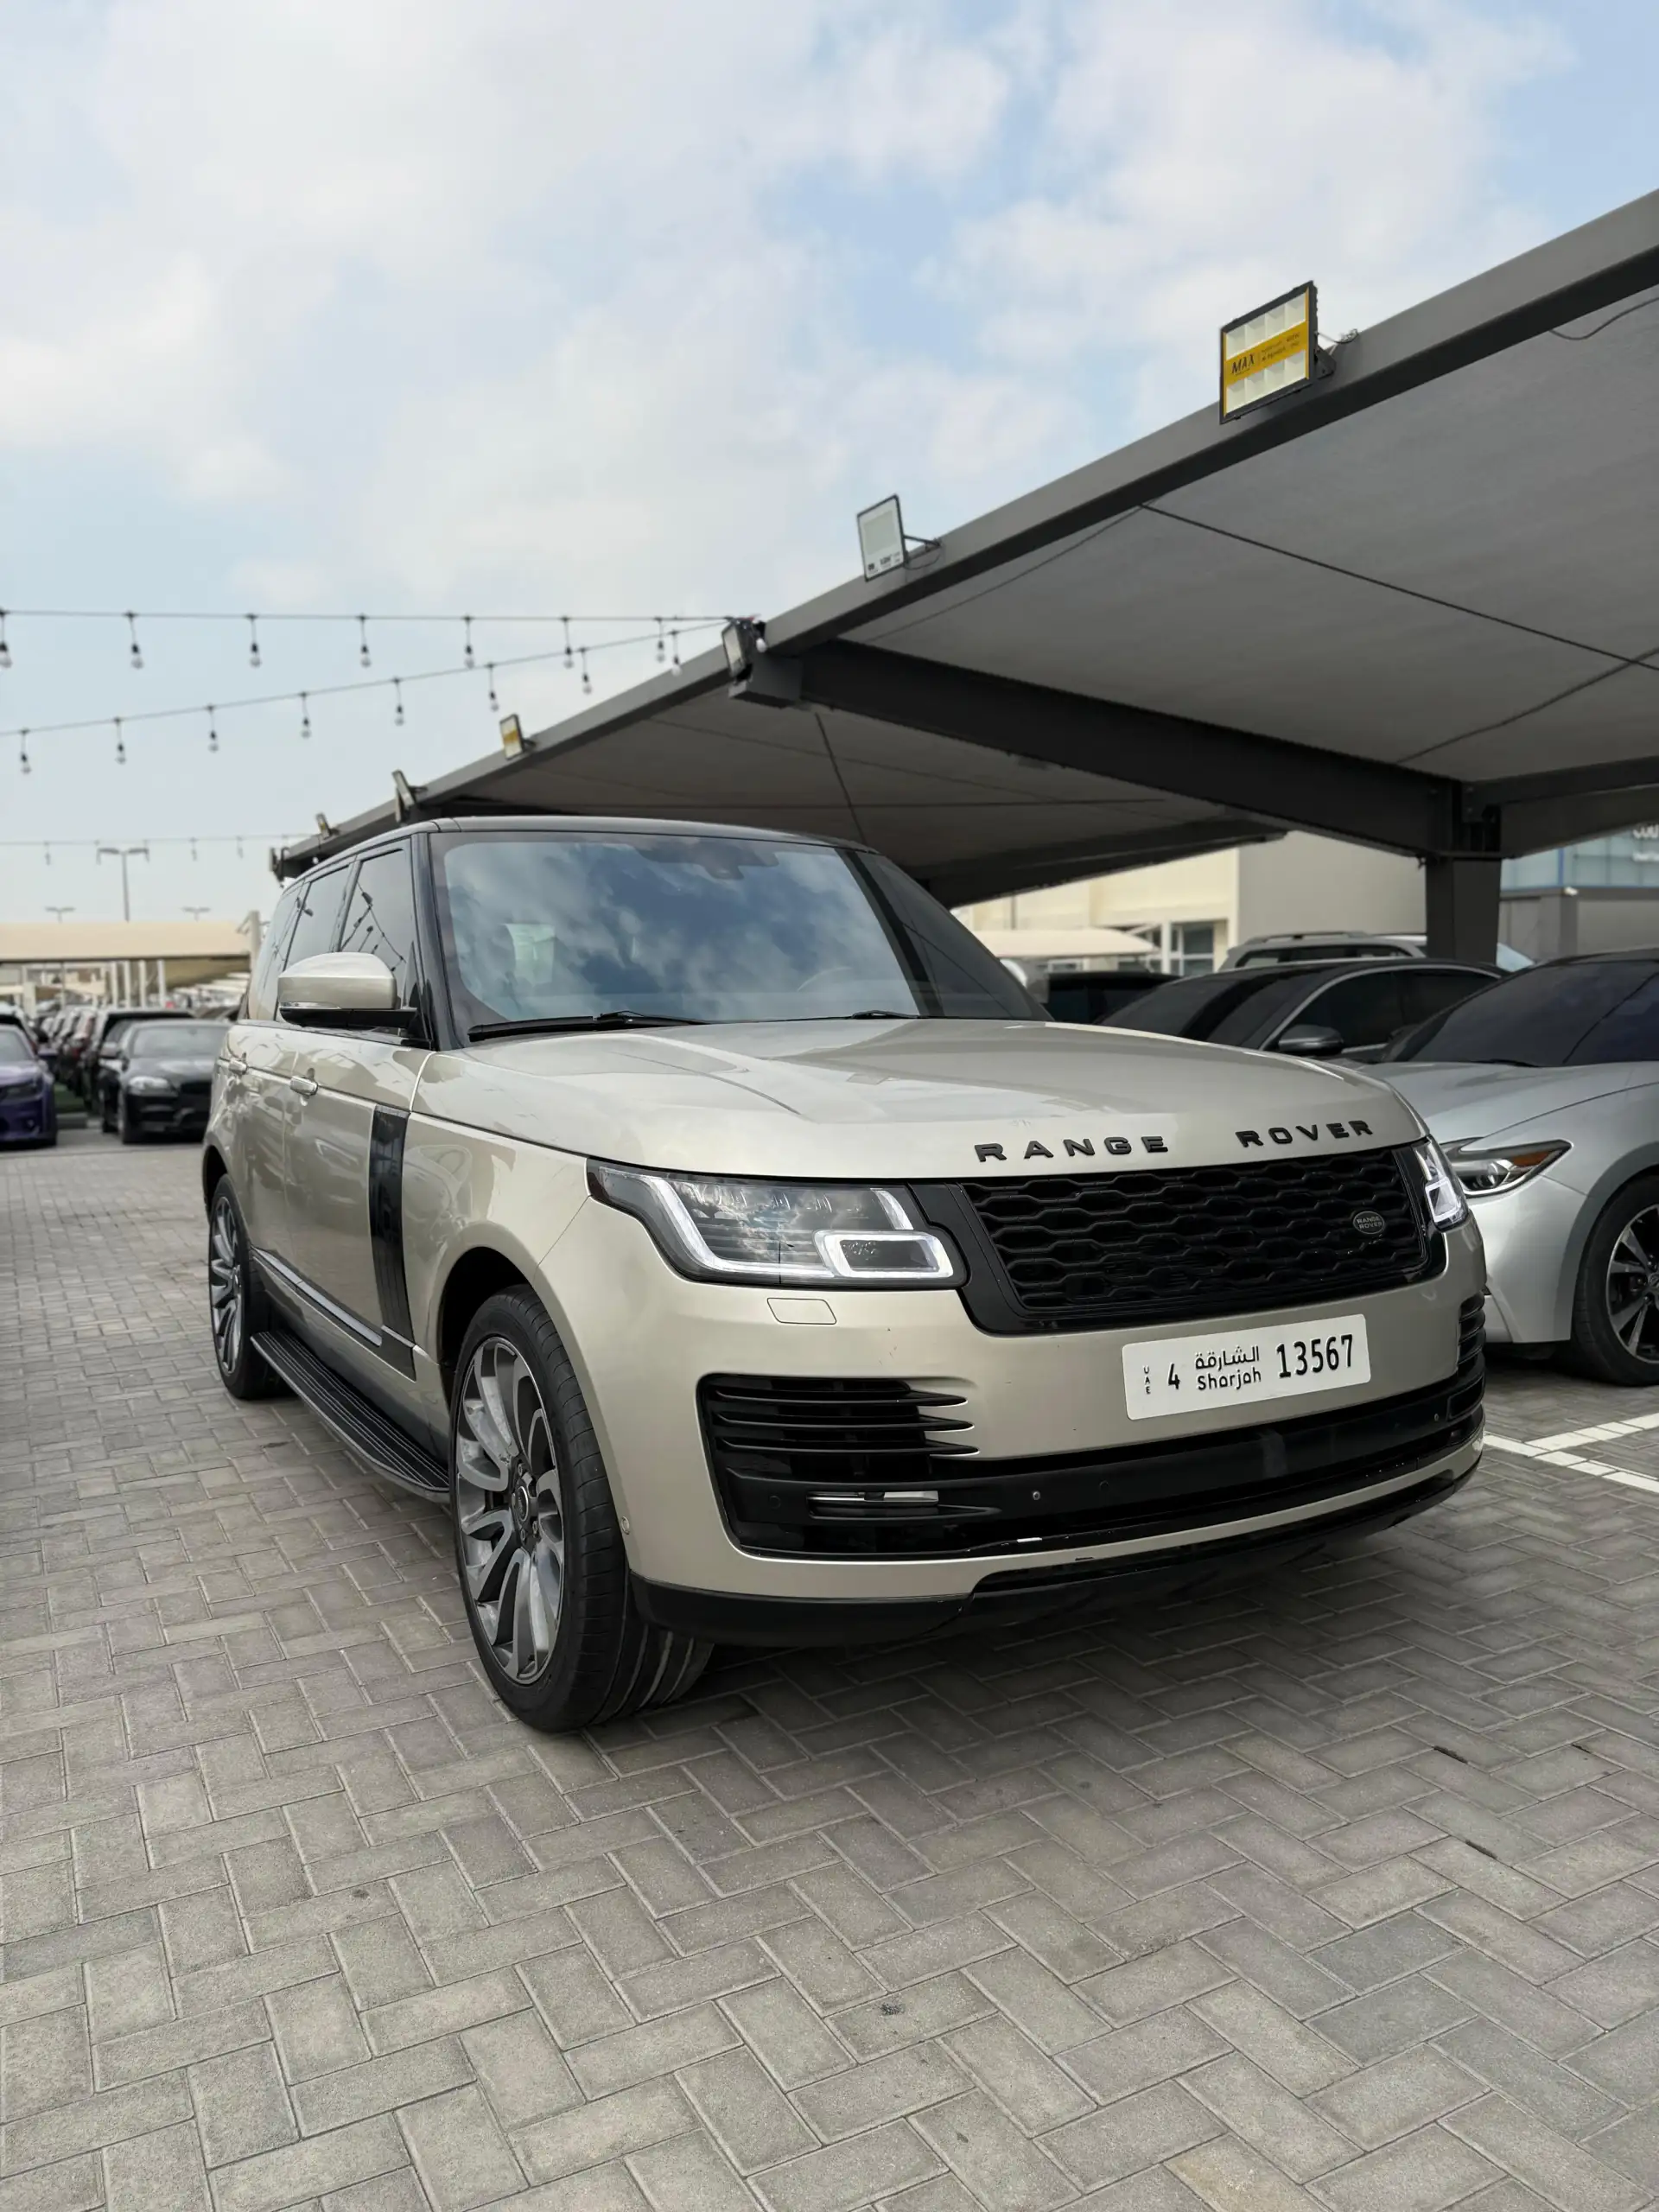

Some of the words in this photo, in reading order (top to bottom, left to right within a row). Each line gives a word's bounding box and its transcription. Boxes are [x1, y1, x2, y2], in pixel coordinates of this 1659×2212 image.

[1231, 353, 1255, 374] MAX
[974, 1135, 1169, 1163] RANGE
[1236, 1120, 1374, 1148] ROVER
[1358, 1221, 1382, 1230] ROVER
[1194, 1345, 1261, 1371] الشارقة
[1274, 1333, 1354, 1379] 13567
[1167, 1363, 1181, 1390] 4
[1197, 1367, 1262, 1390] Sharjah
